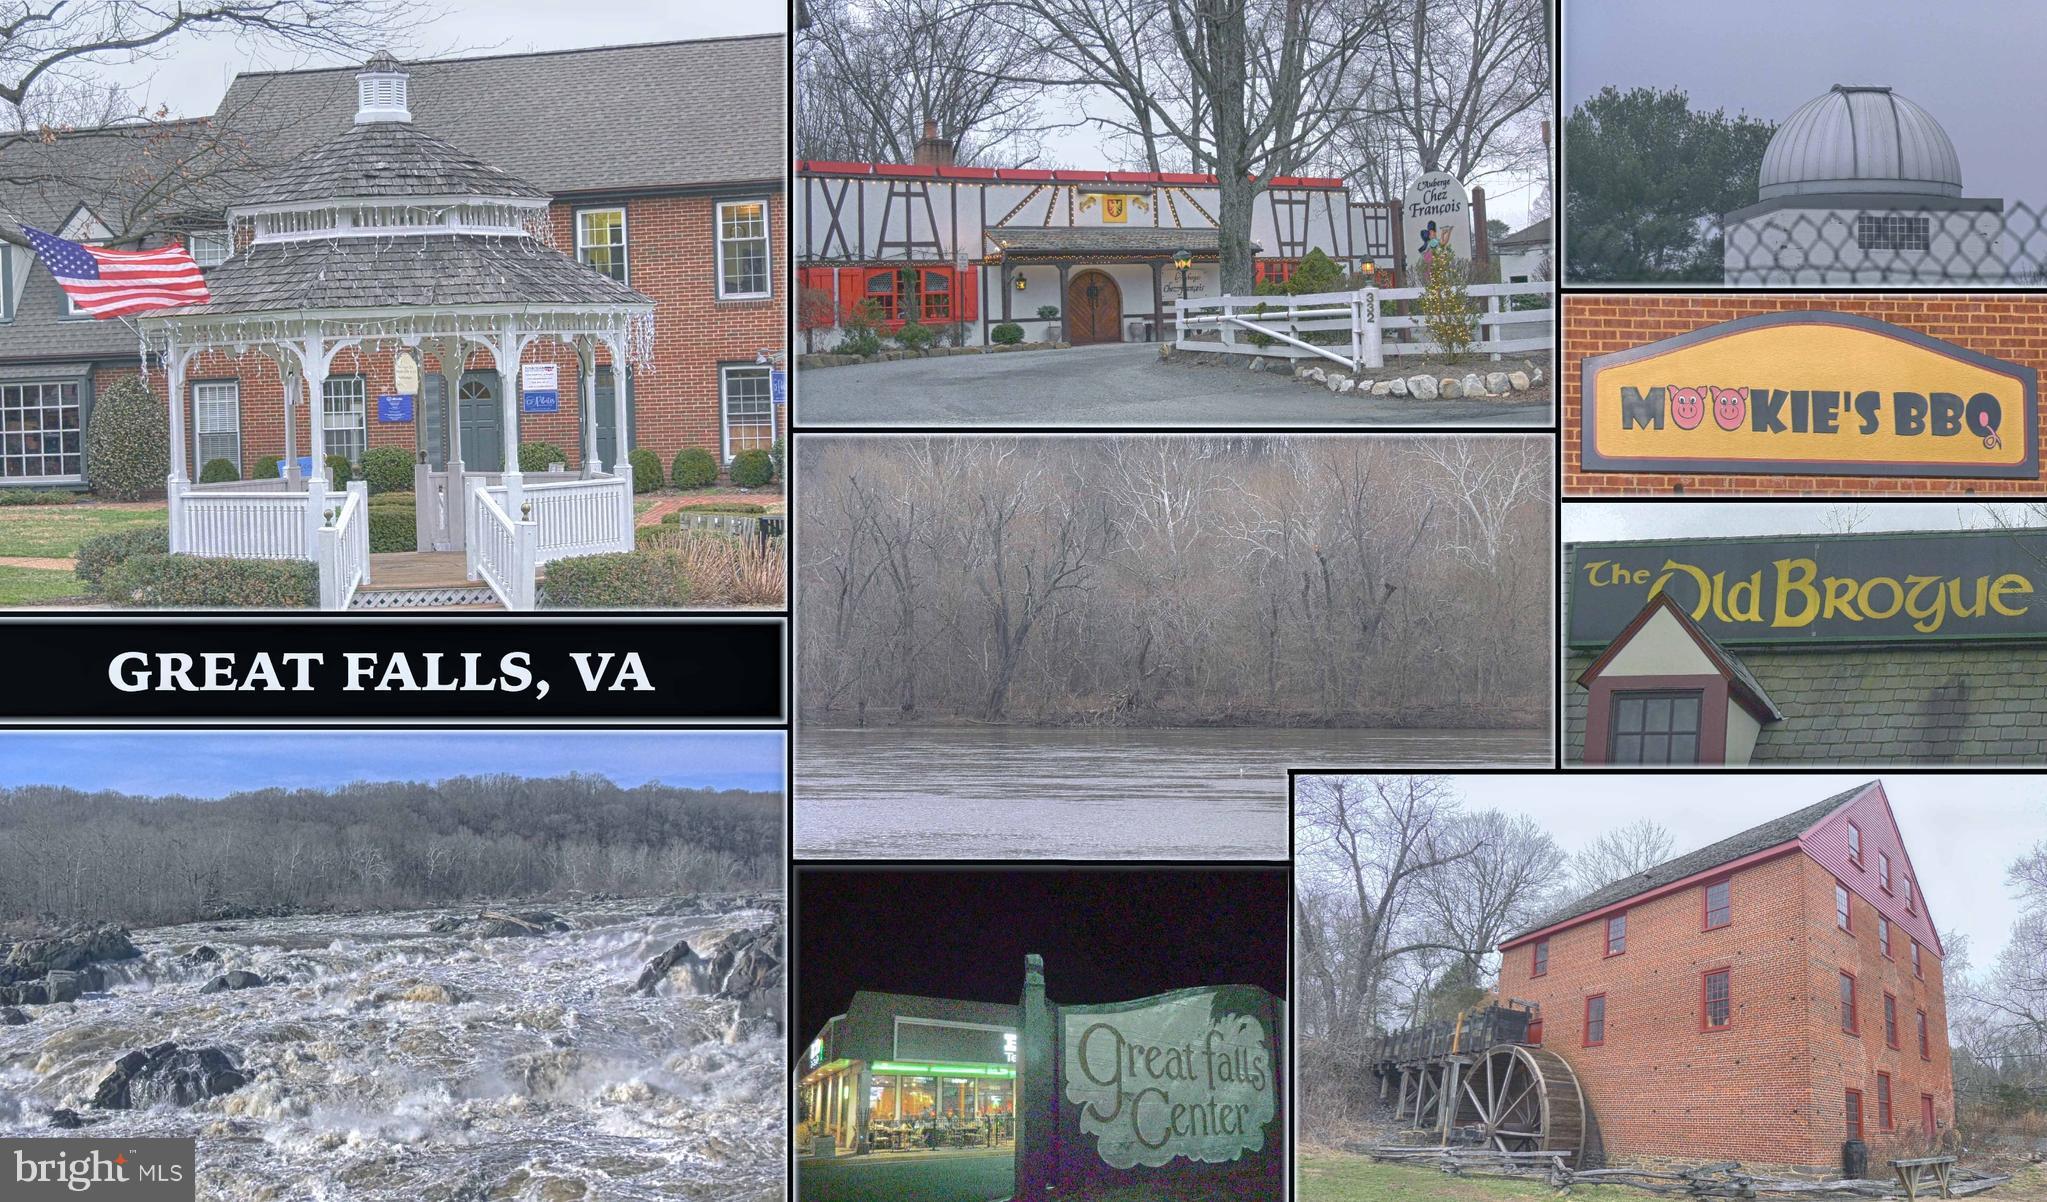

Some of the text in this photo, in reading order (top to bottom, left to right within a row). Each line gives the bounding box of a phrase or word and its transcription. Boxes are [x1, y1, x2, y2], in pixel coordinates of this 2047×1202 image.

[1416, 178, 1451, 191] L'Auberge
[1423, 188, 1448, 205] Chez
[1408, 200, 1461, 218] François
[1366, 292, 1375, 323] 332
[1620, 384, 2003, 449] MOOKIE'S BBQ
[1583, 560, 1650, 587] The
[1647, 559, 1764, 623] Old
[1132, 1087, 1250, 1149] Center
